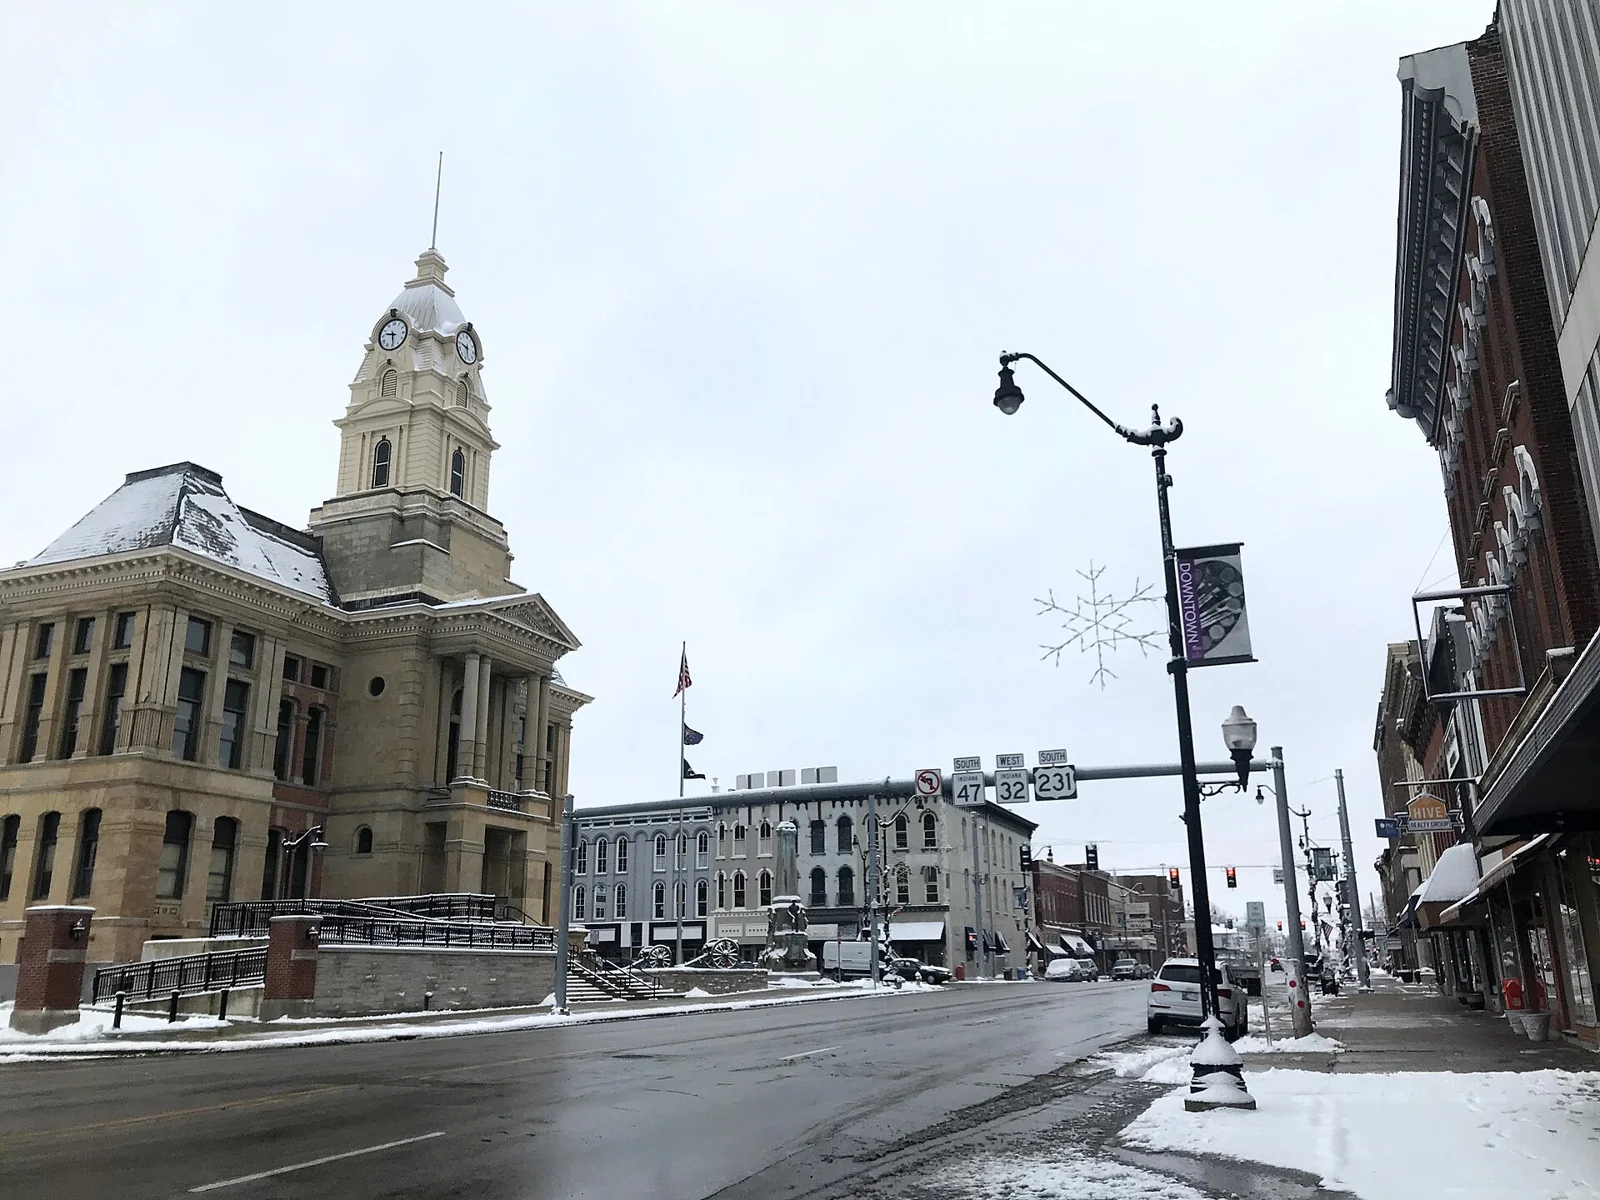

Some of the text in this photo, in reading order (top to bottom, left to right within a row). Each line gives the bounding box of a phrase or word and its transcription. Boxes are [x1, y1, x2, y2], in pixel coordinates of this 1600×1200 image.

[1179, 562, 1199, 644] DOWNTOWN
[1000, 756, 1021, 766] WEST
[1040, 752, 1065, 762] SOUTH
[955, 759, 980, 770] SOUTH
[1038, 773, 1071, 792] 231
[957, 784, 981, 802] 47
[1000, 781, 1026, 801] 32
[1413, 806, 1443, 819] HIVE
[1431, 820, 1449, 828] GROUP
